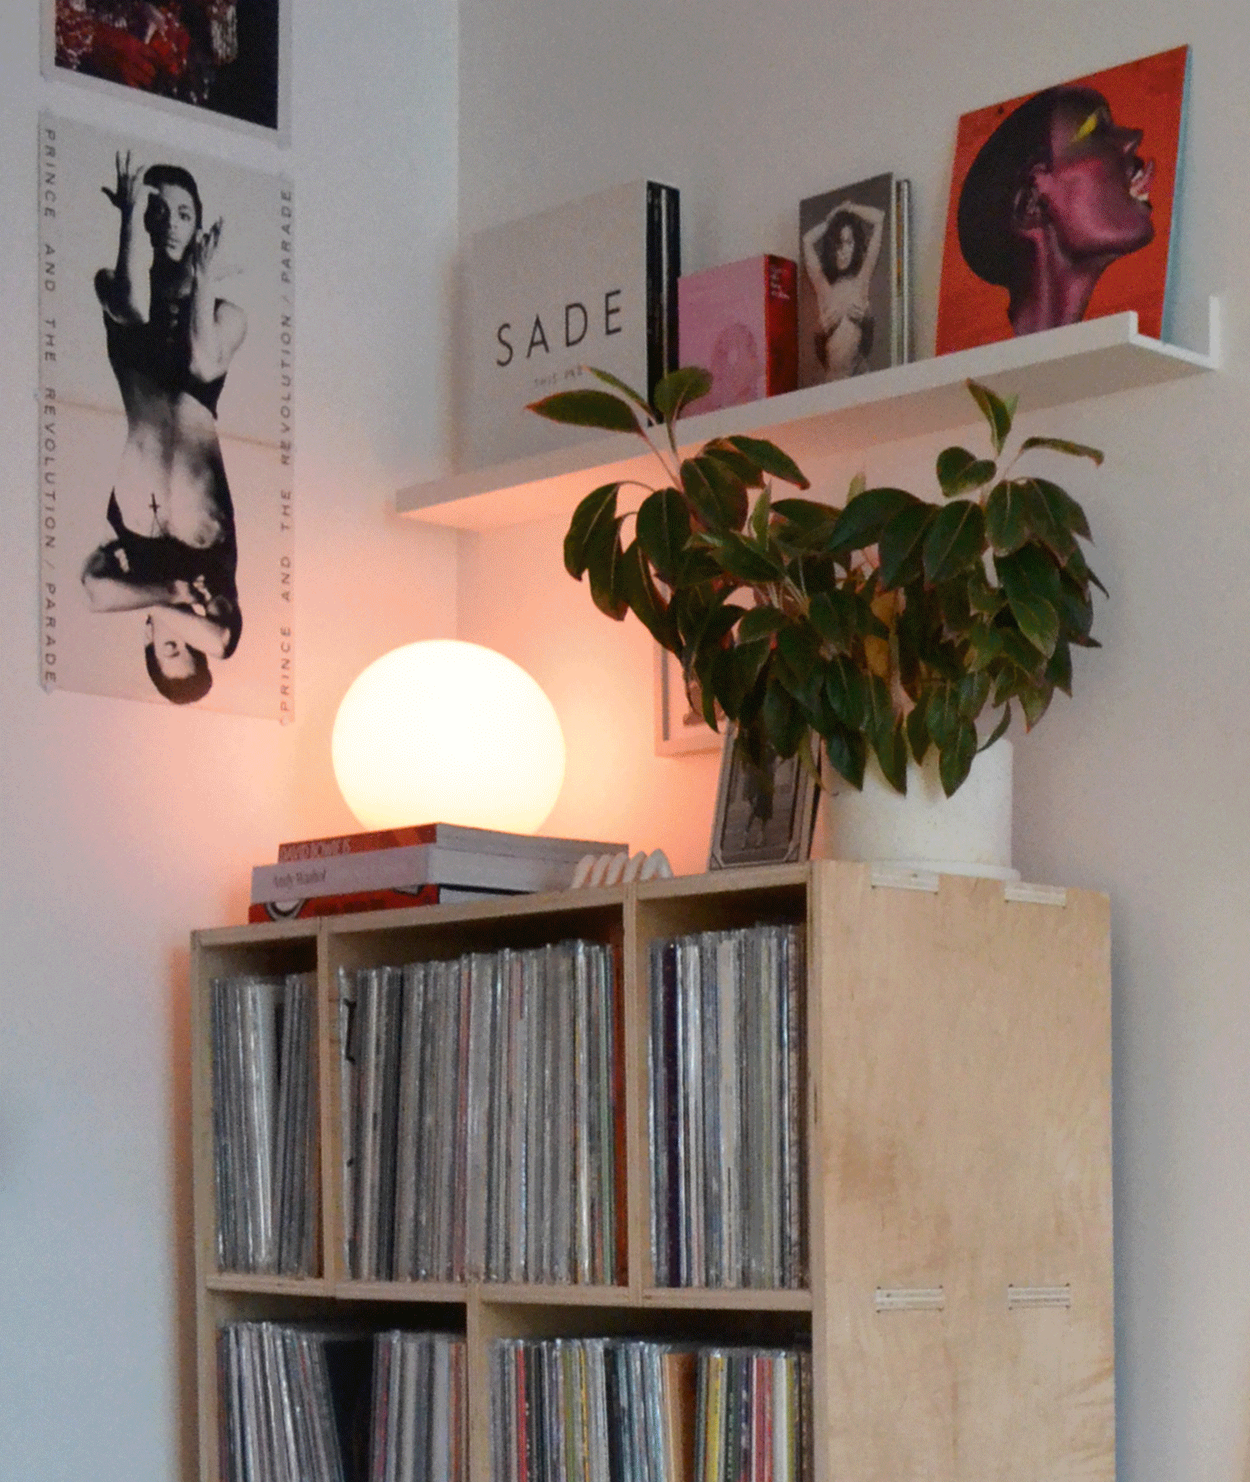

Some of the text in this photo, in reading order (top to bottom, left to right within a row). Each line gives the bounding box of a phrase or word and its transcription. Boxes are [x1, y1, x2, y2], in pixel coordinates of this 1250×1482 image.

[44, 128, 57, 218] PRINCE
[44, 243, 57, 293] AND
[281, 190, 292, 284] PARADE
[44, 318, 57, 362] THE
[495, 289, 622, 367] SADE
[280, 314, 292, 466] REVOLUTION
[44, 387, 57, 549] REVOLUTION
[280, 489, 292, 532] THE
[280, 556, 292, 603] AND
[44, 582, 57, 683] PARADE
[280, 626, 292, 712] PRINCE
